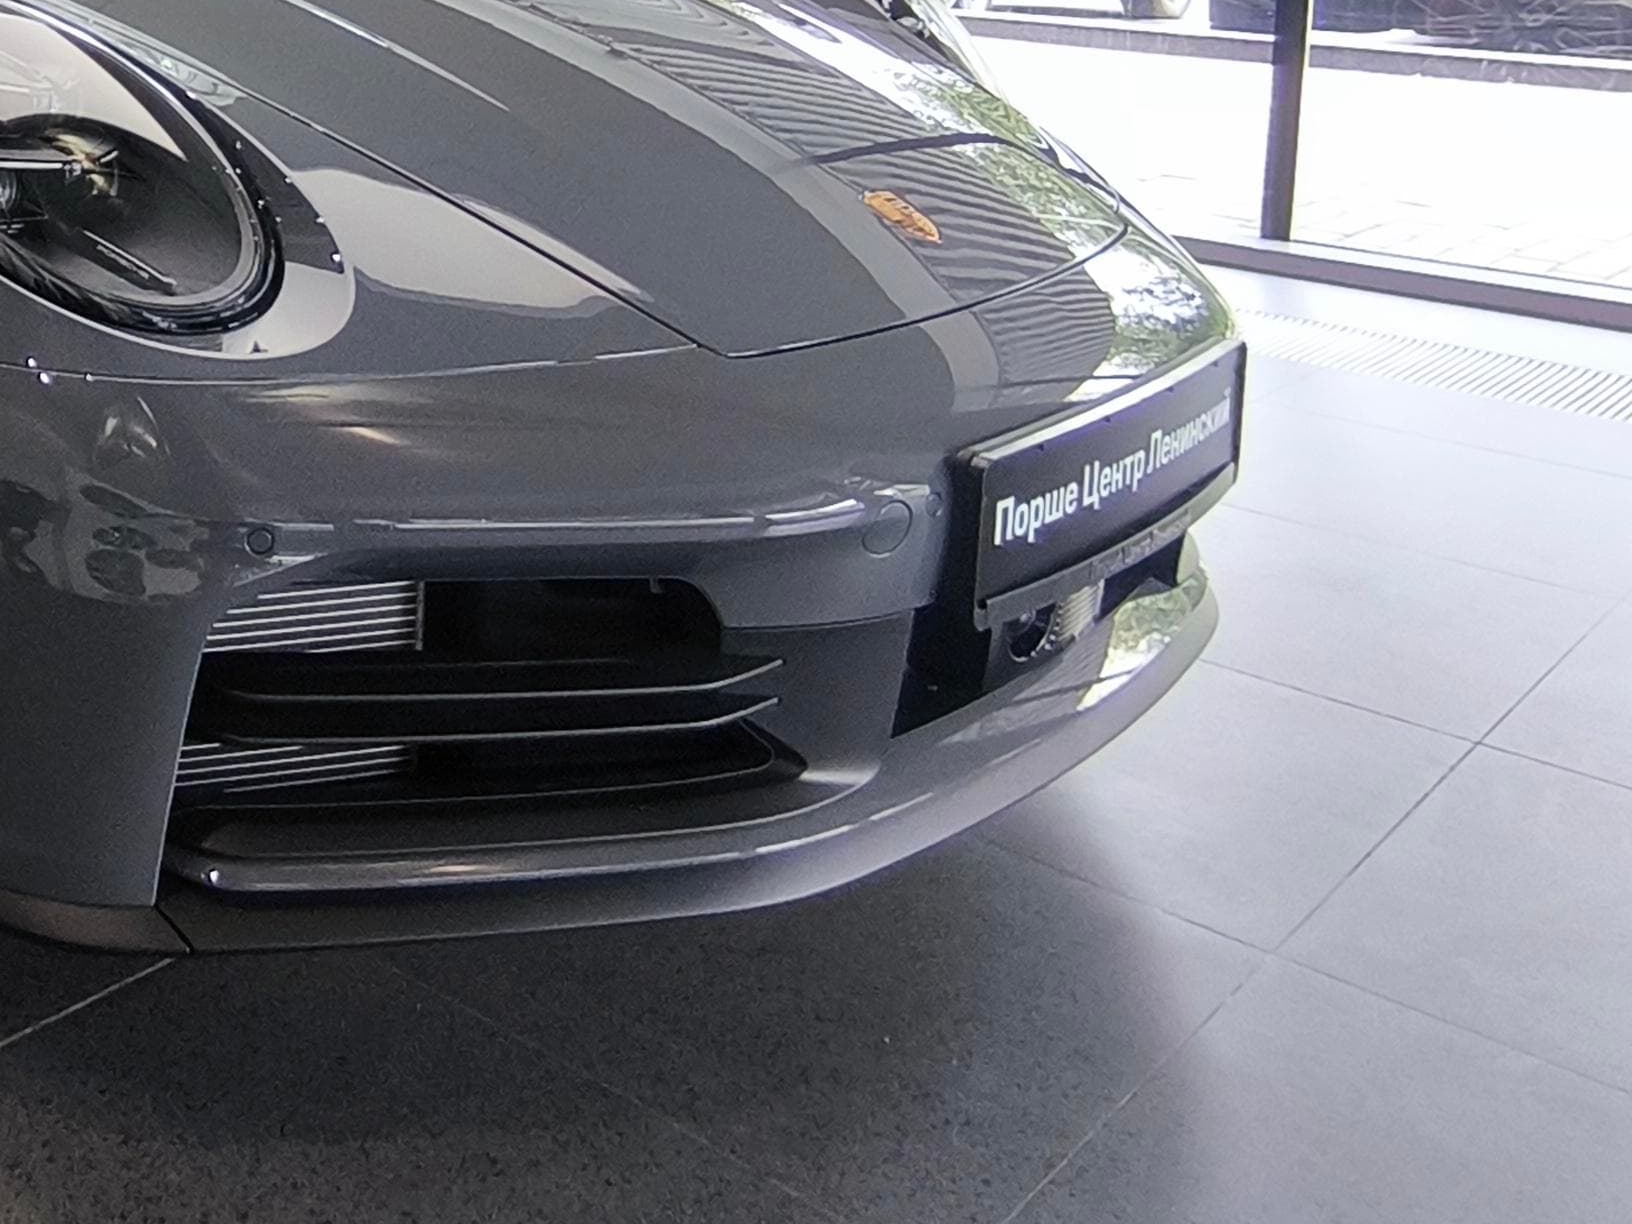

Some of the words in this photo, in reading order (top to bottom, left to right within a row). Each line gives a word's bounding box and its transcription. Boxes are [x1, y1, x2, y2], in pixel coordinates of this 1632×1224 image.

[994, 481, 1078, 546] Порше
[1082, 450, 1145, 510] Центр
[1146, 387, 1231, 474] Ленинский
